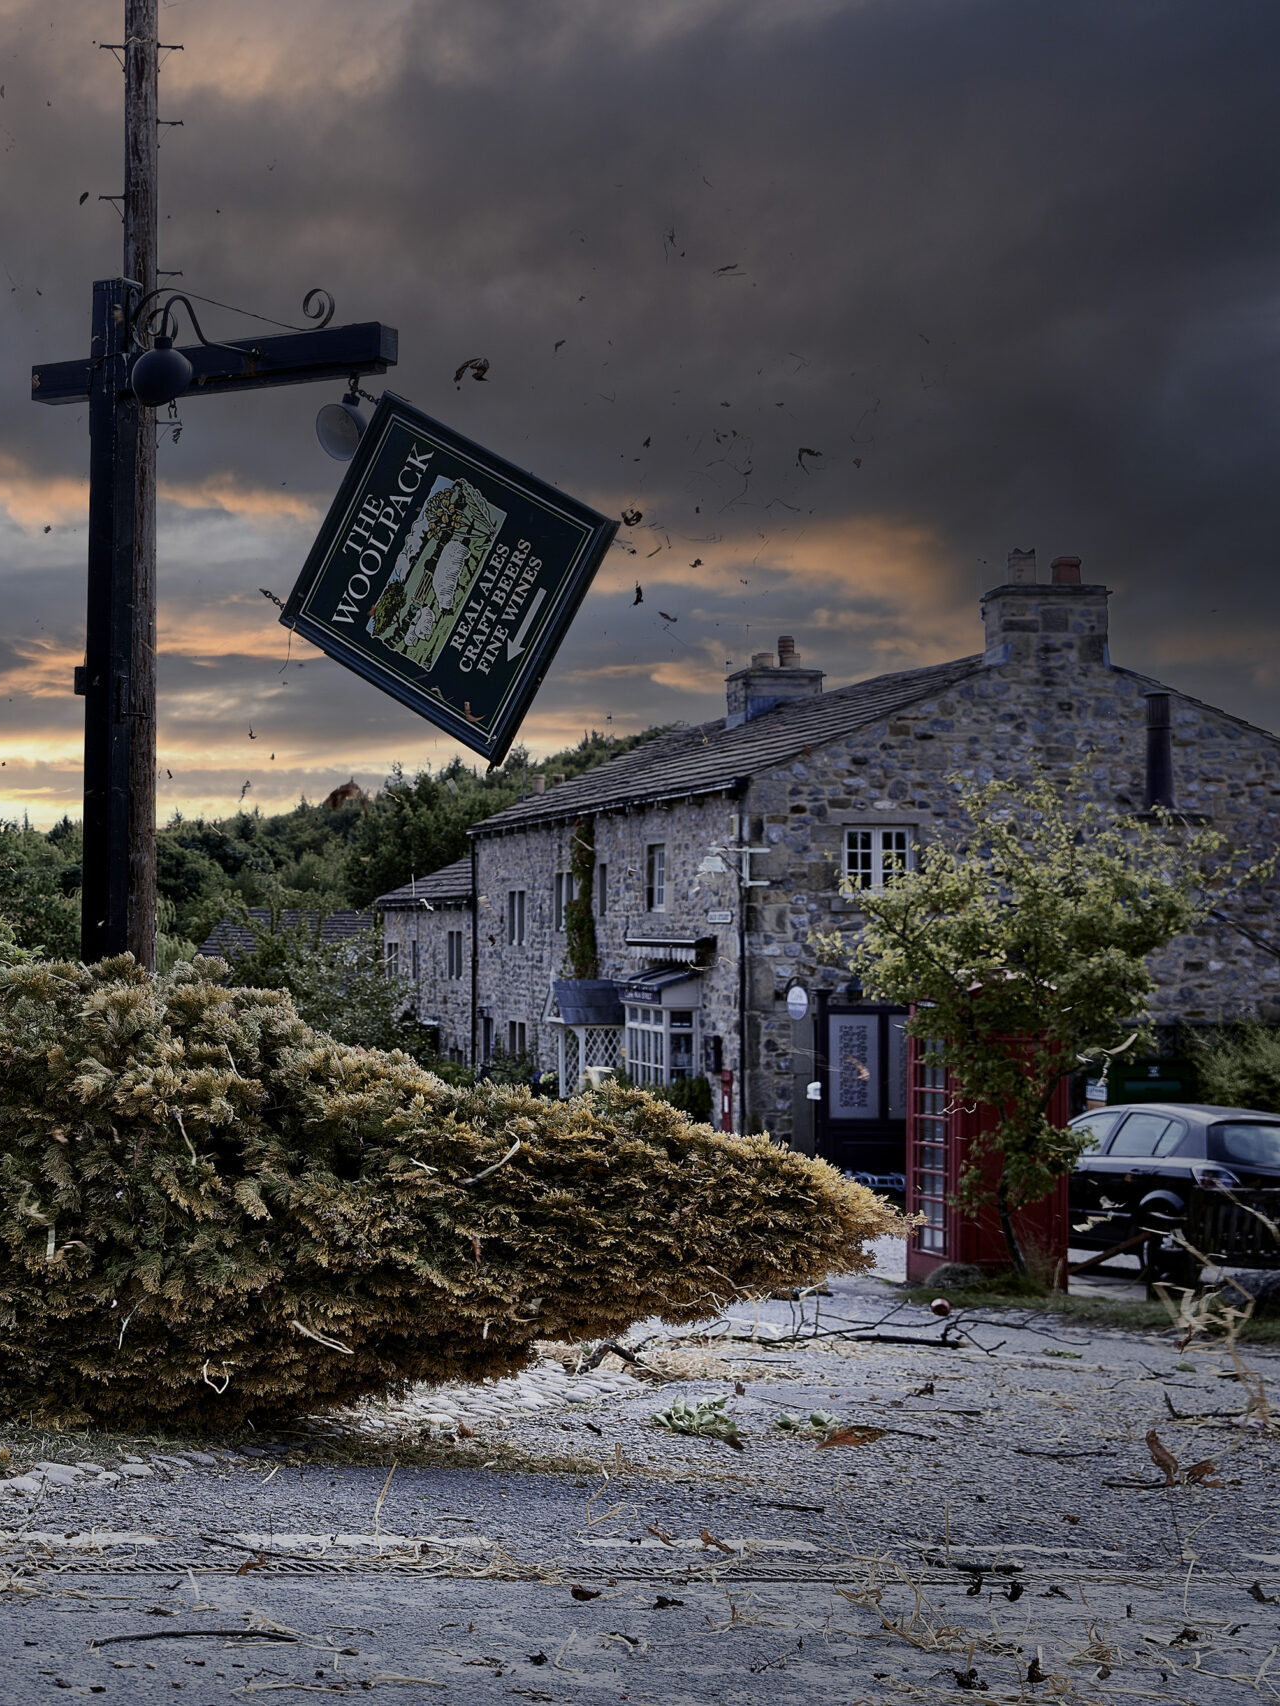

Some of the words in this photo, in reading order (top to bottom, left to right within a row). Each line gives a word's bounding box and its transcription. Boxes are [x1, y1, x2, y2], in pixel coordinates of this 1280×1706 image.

[331, 442, 435, 626] WOOLPACK
[342, 494, 385, 555] THE
[450, 598, 485, 652] REAL
[478, 543, 510, 597] ALES
[459, 606, 498, 673] CRAFT
[490, 538, 531, 607] BEERS
[477, 625, 509, 676] FINE
[500, 555, 543, 621] WINES
